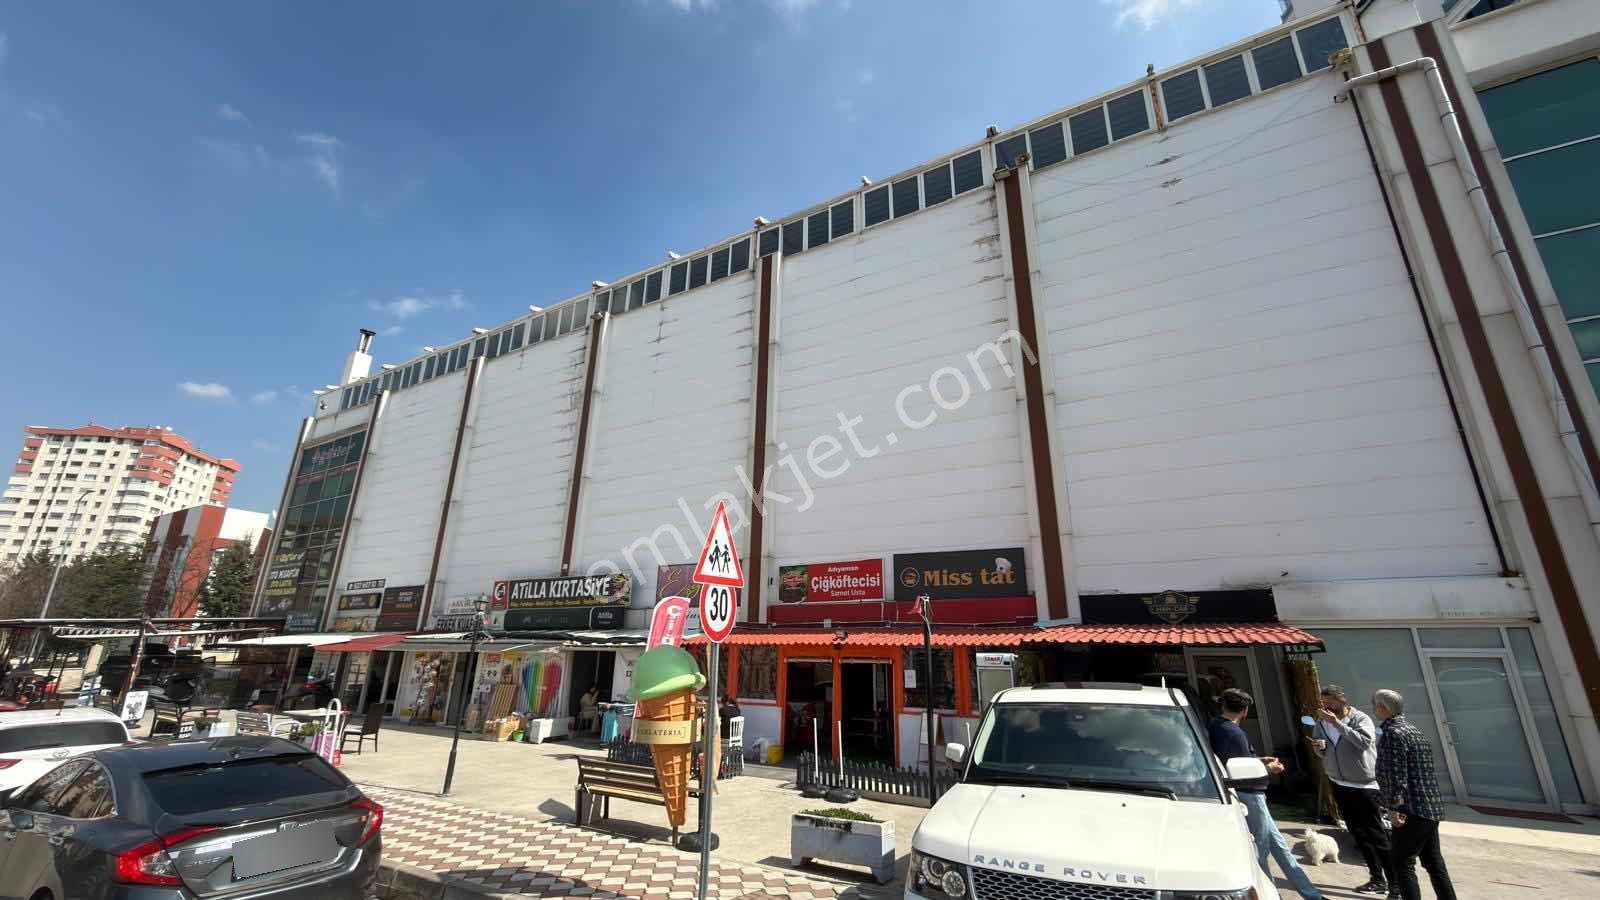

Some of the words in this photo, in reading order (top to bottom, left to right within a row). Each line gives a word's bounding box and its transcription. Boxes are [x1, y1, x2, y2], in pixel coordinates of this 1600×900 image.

[811, 573, 881, 593] Çiğköftecisi
[924, 569, 972, 588] Miss
[980, 568, 1016, 585] tat
[710, 587, 728, 622] 30
[974, 854, 1045, 873] RANGE
[1063, 866, 1147, 886] ROVER
